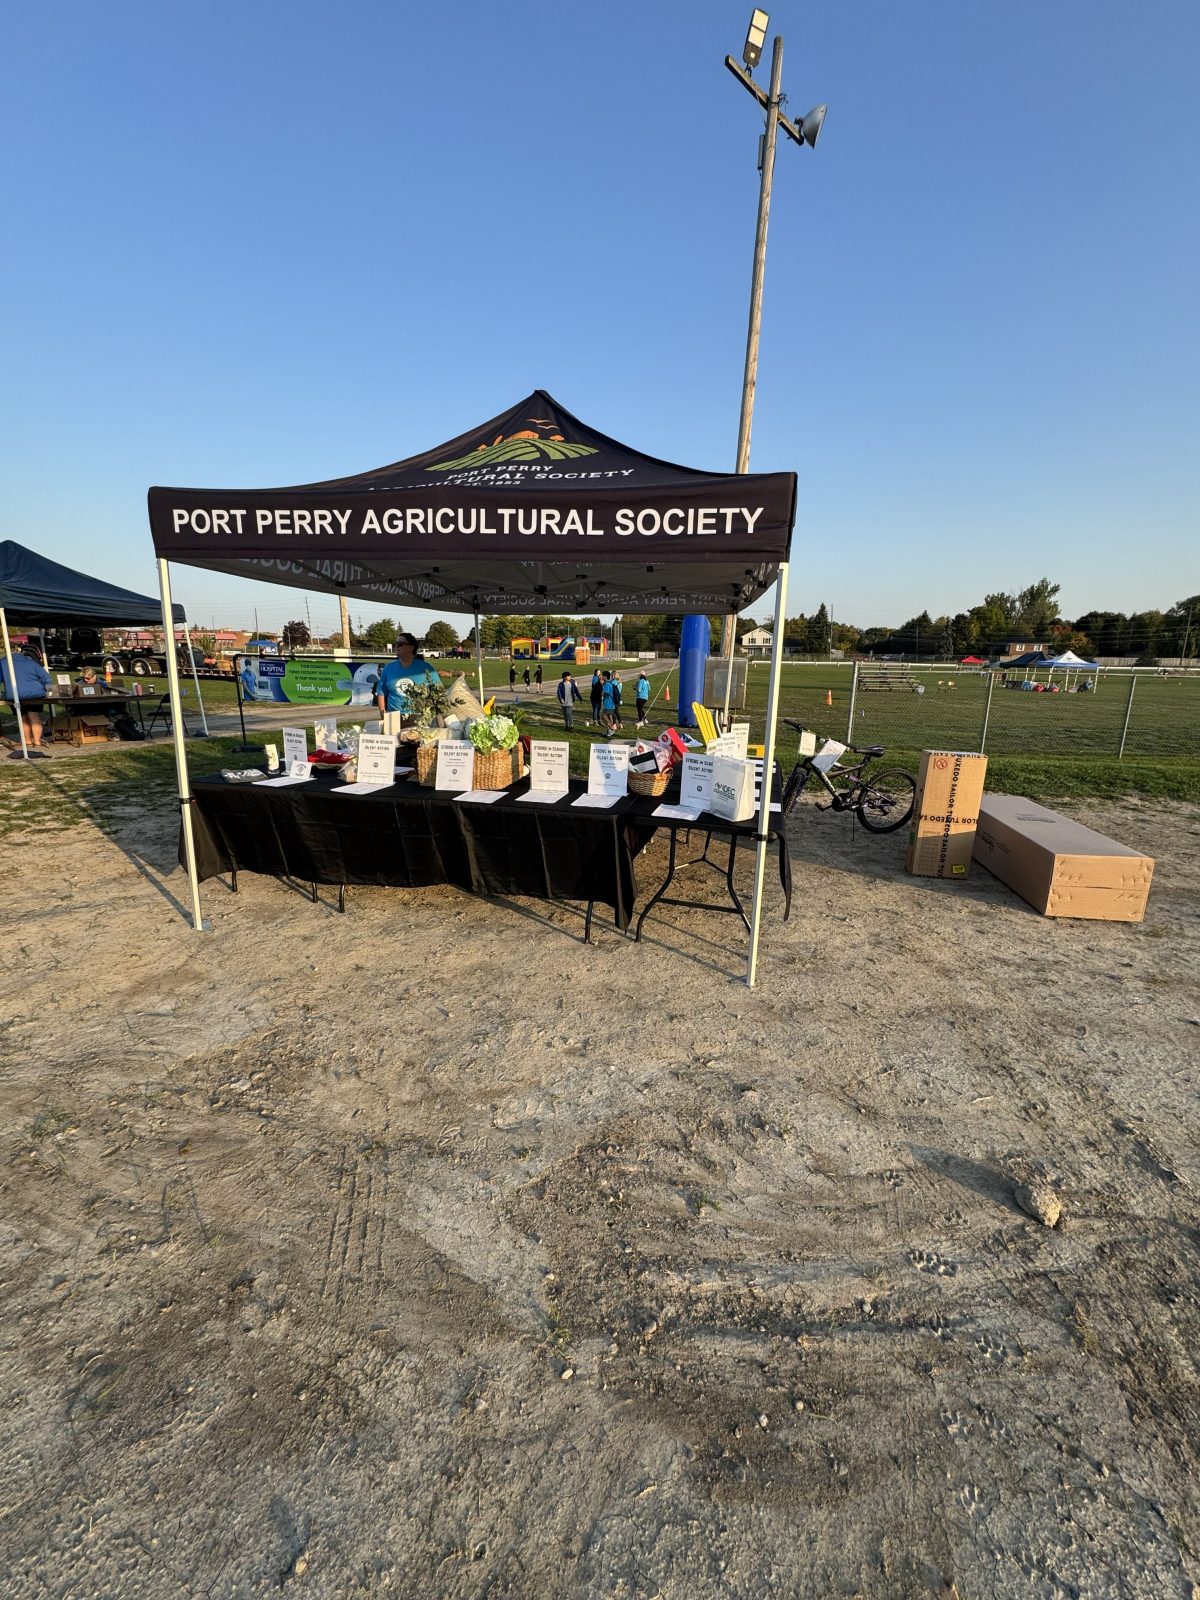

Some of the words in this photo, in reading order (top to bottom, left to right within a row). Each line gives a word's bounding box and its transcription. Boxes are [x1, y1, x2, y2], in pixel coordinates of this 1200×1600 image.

[446, 468, 491, 480] PORT
[534, 469, 635, 480] SOCIETY
[172, 508, 248, 535] PORT
[255, 508, 353, 535] PERRY
[360, 507, 605, 536] AGRICULTURAL
[614, 507, 765, 536] SOCIETY
[296, 683, 317, 692] Thank
[318, 685, 333, 694] you!
[947, 783, 958, 809] SAILOR
[938, 838, 949, 863] SAILOR
